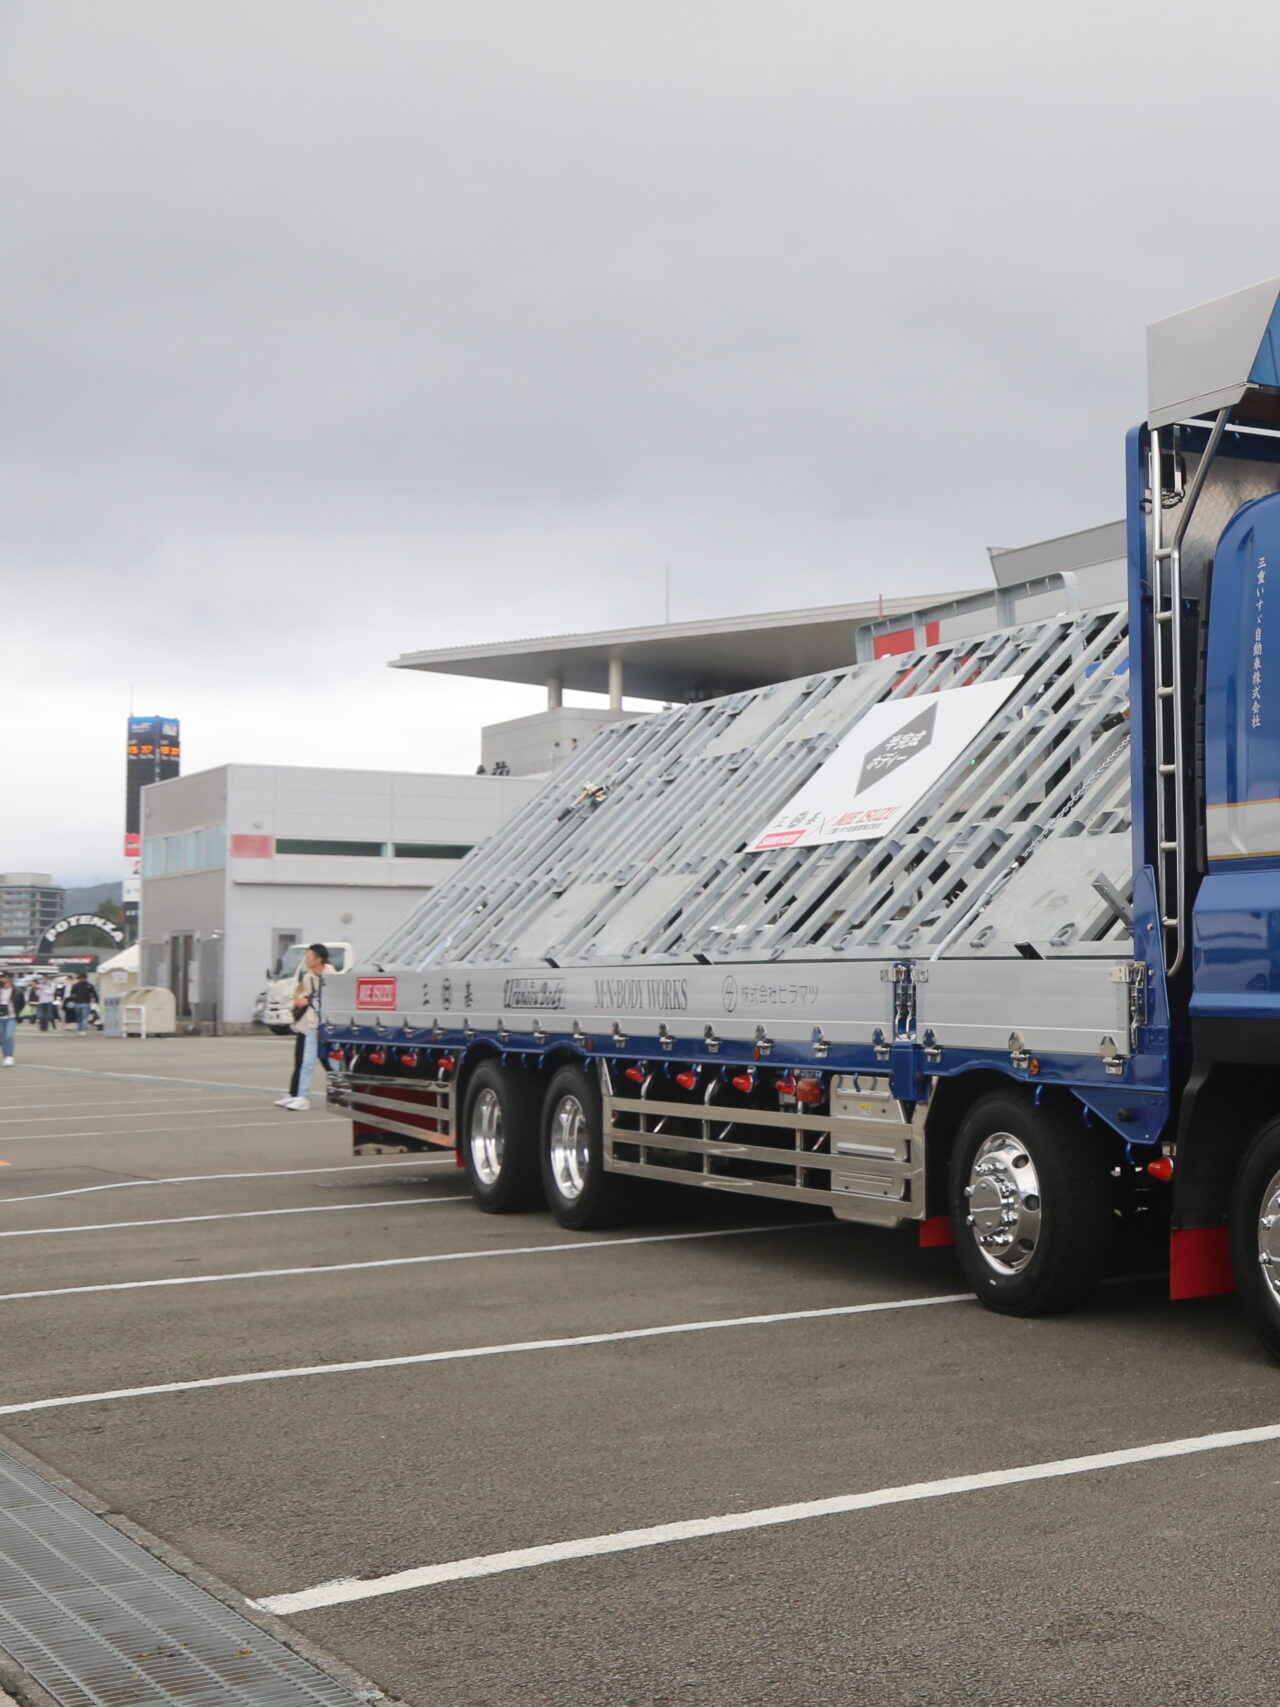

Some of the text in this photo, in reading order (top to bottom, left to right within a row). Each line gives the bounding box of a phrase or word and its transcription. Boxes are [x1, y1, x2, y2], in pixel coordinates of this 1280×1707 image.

[45, 914, 124, 942] POTENZA
[647, 978, 688, 1010] WORKS
[740, 984, 819, 1005] 株式会社ヒラマツ
